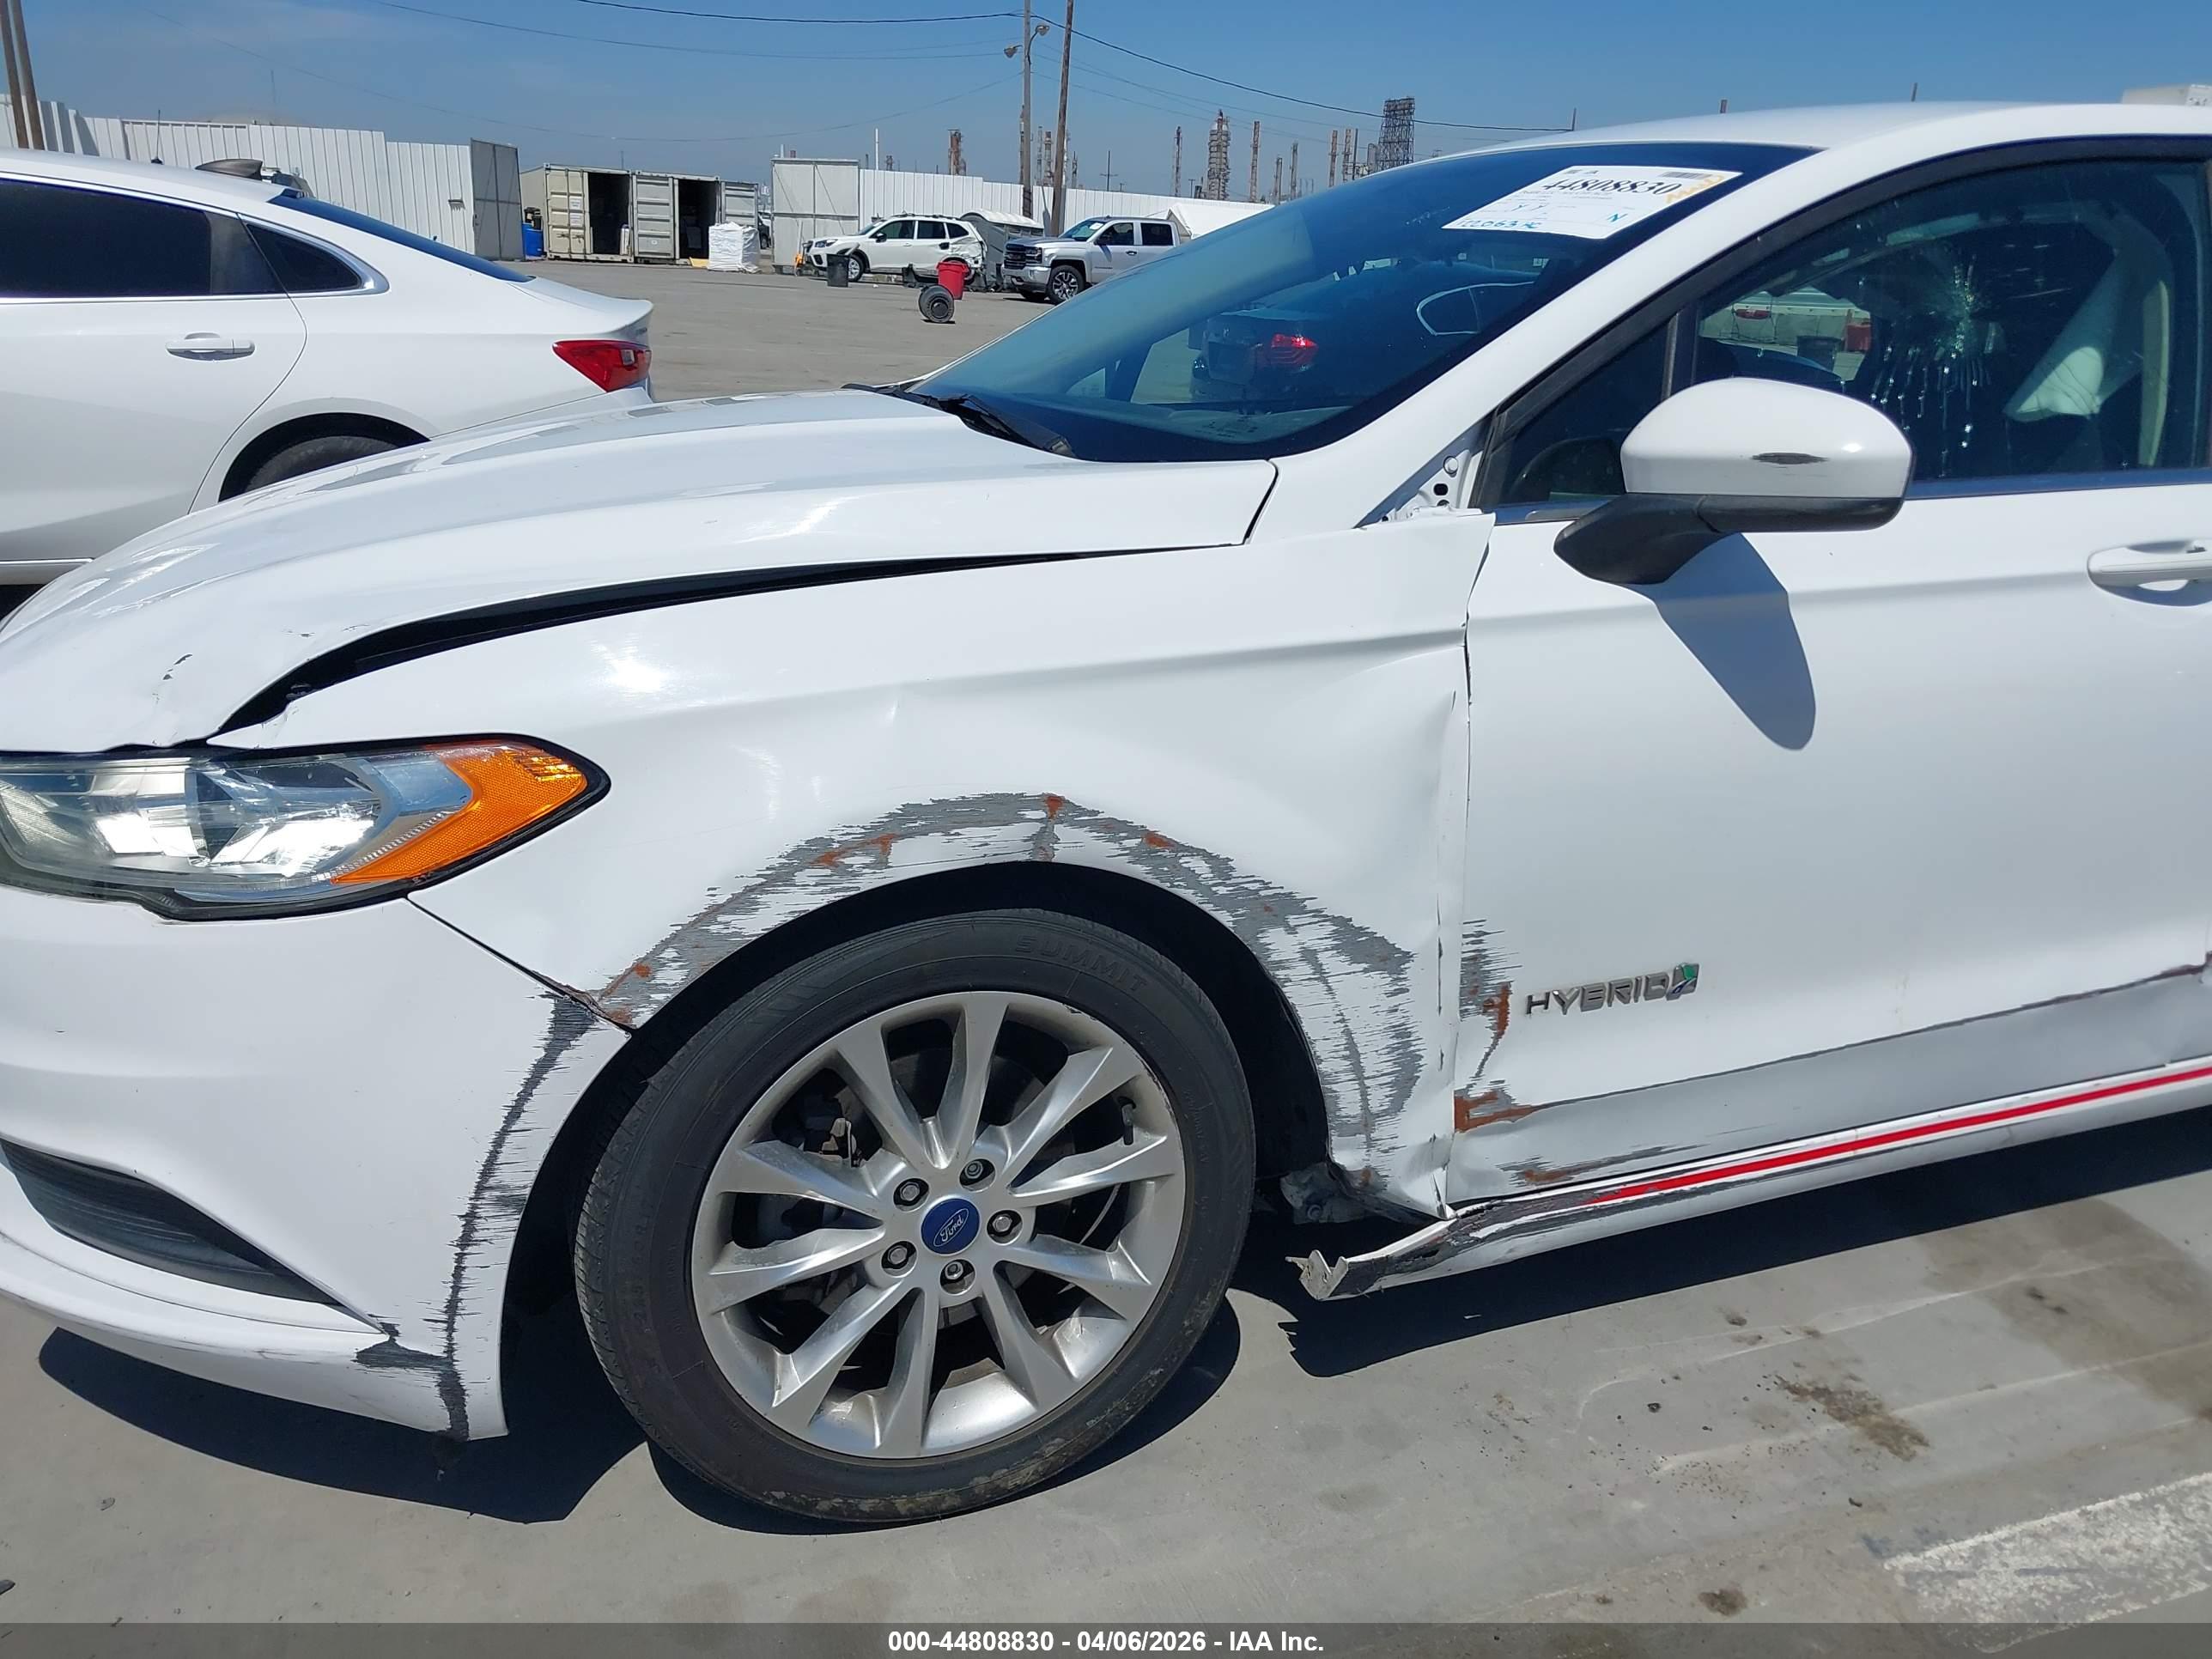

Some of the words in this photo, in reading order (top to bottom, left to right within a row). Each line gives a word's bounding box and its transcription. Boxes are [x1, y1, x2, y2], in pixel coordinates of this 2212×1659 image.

[1543, 179, 1682, 195] 44808830
[1526, 971, 1670, 1015] HYBRID
[939, 1214, 963, 1242] Ford
